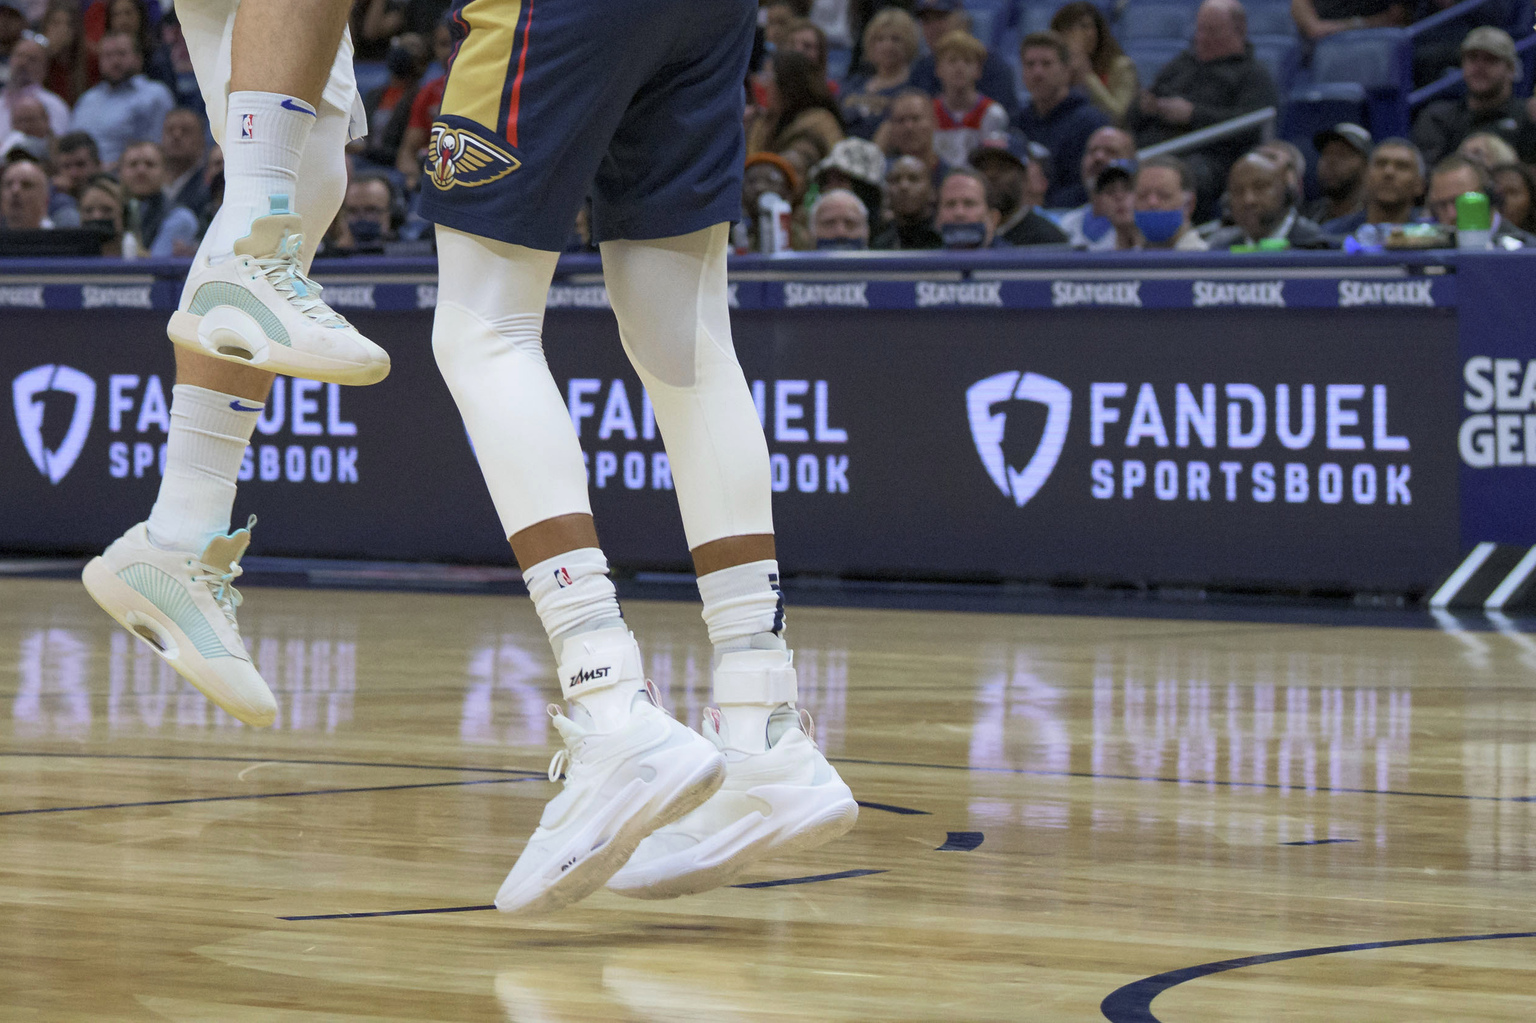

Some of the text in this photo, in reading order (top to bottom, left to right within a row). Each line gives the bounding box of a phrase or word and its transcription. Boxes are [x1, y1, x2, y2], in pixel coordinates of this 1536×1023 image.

[1192, 280, 1285, 307] SEATGEEK
[1337, 279, 1435, 307] SEATGEEK
[108, 373, 358, 437] FAUEL
[566, 377, 849, 443] FAEL
[1089, 382, 1411, 451] FANDUEL
[108, 440, 359, 485] SPSBOOK
[581, 450, 850, 494] POROOK
[1089, 459, 1412, 506] SPORTSBOOK
[569, 666, 612, 688] ZAMST
